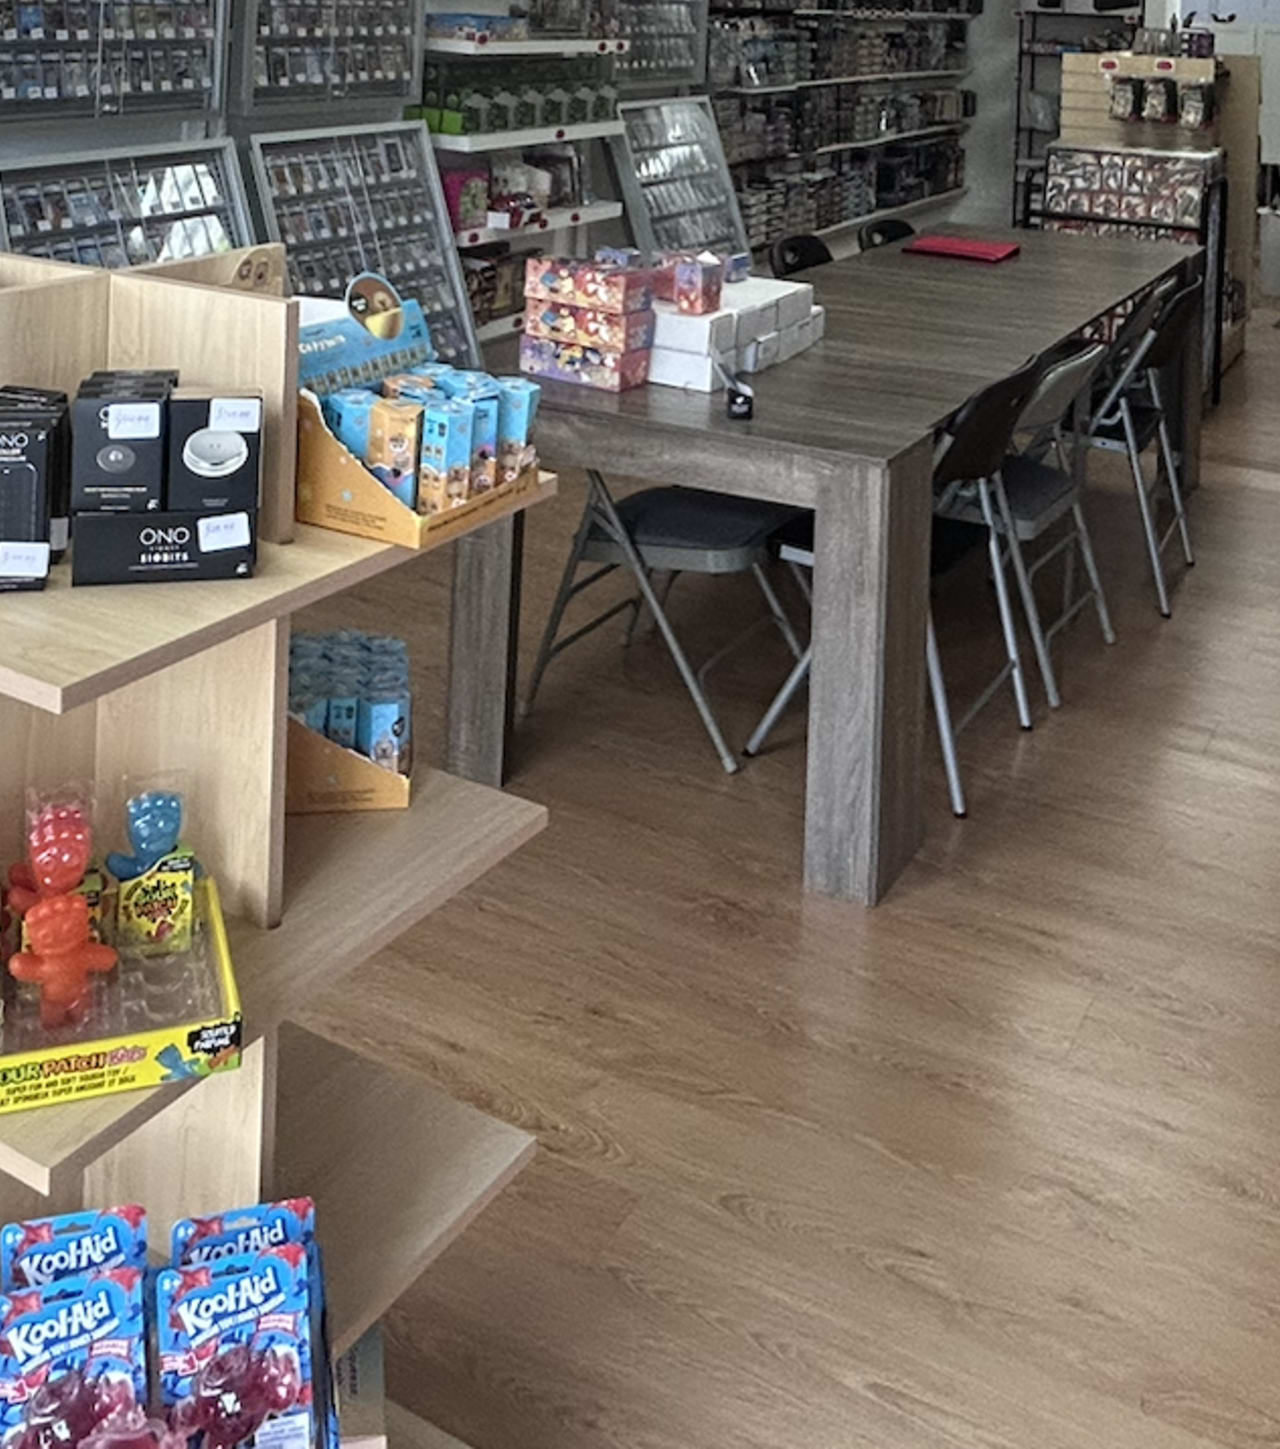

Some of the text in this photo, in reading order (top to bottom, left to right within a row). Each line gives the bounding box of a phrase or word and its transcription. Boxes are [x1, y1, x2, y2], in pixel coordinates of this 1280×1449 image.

[140, 527, 190, 545] ONO
[42, 1052, 108, 1078] PATCH
[20, 1226, 117, 1286] Kool-Aid
[7, 1290, 111, 1363] Kool-Aid
[178, 1266, 277, 1337] Kool-Aid
